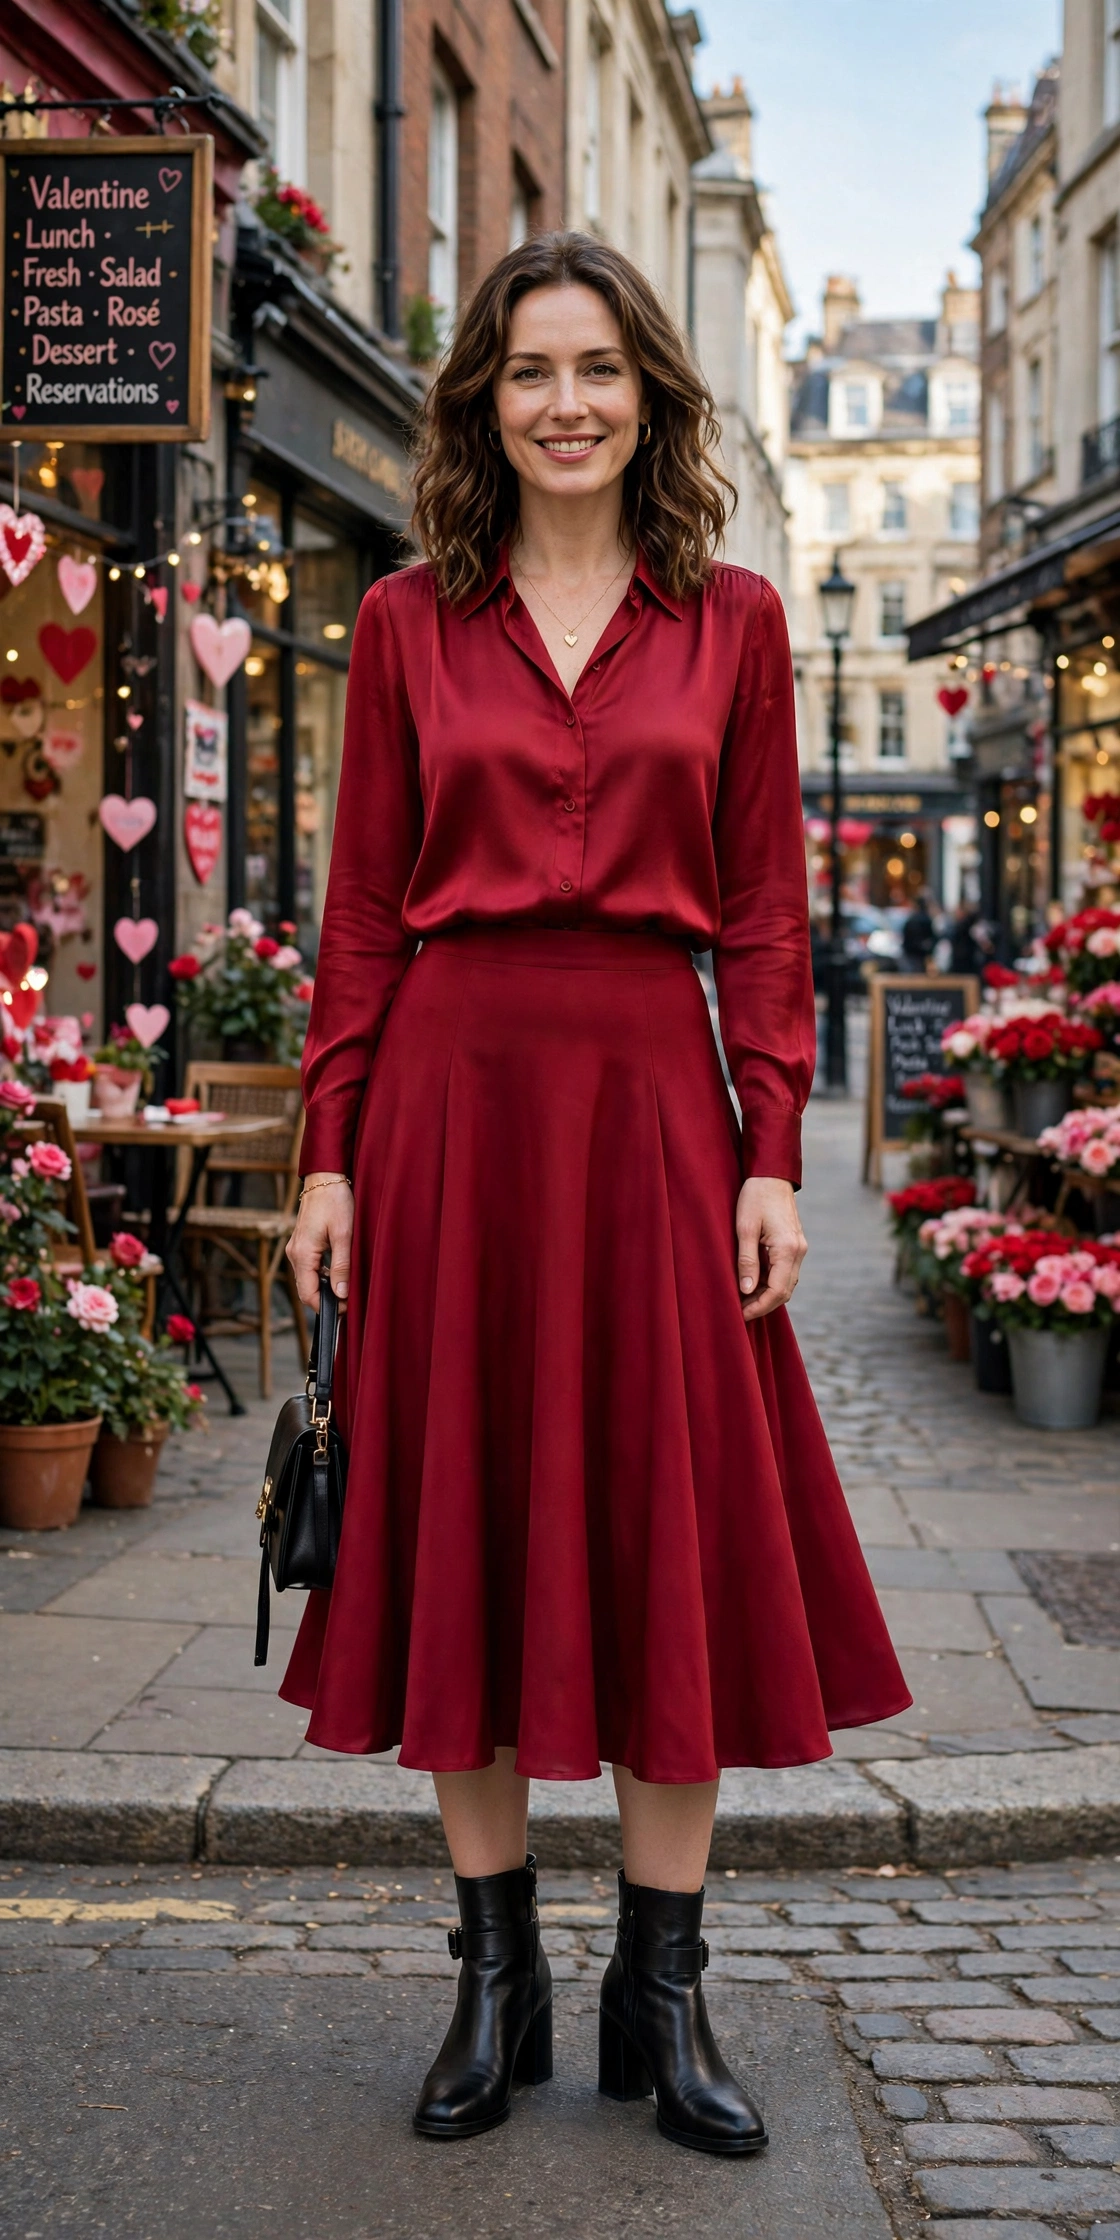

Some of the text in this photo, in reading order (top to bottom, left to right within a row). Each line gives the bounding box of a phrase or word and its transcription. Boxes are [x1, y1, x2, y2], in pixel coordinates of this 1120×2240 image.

[29, 175, 150, 209] Valentine
[25, 218, 95, 249] Lunch
[23, 256, 161, 287] Fresh Salad
[24, 296, 160, 326] Pasta Rosé
[32, 334, 118, 365] Dessert
[26, 373, 159, 404] Reservations
